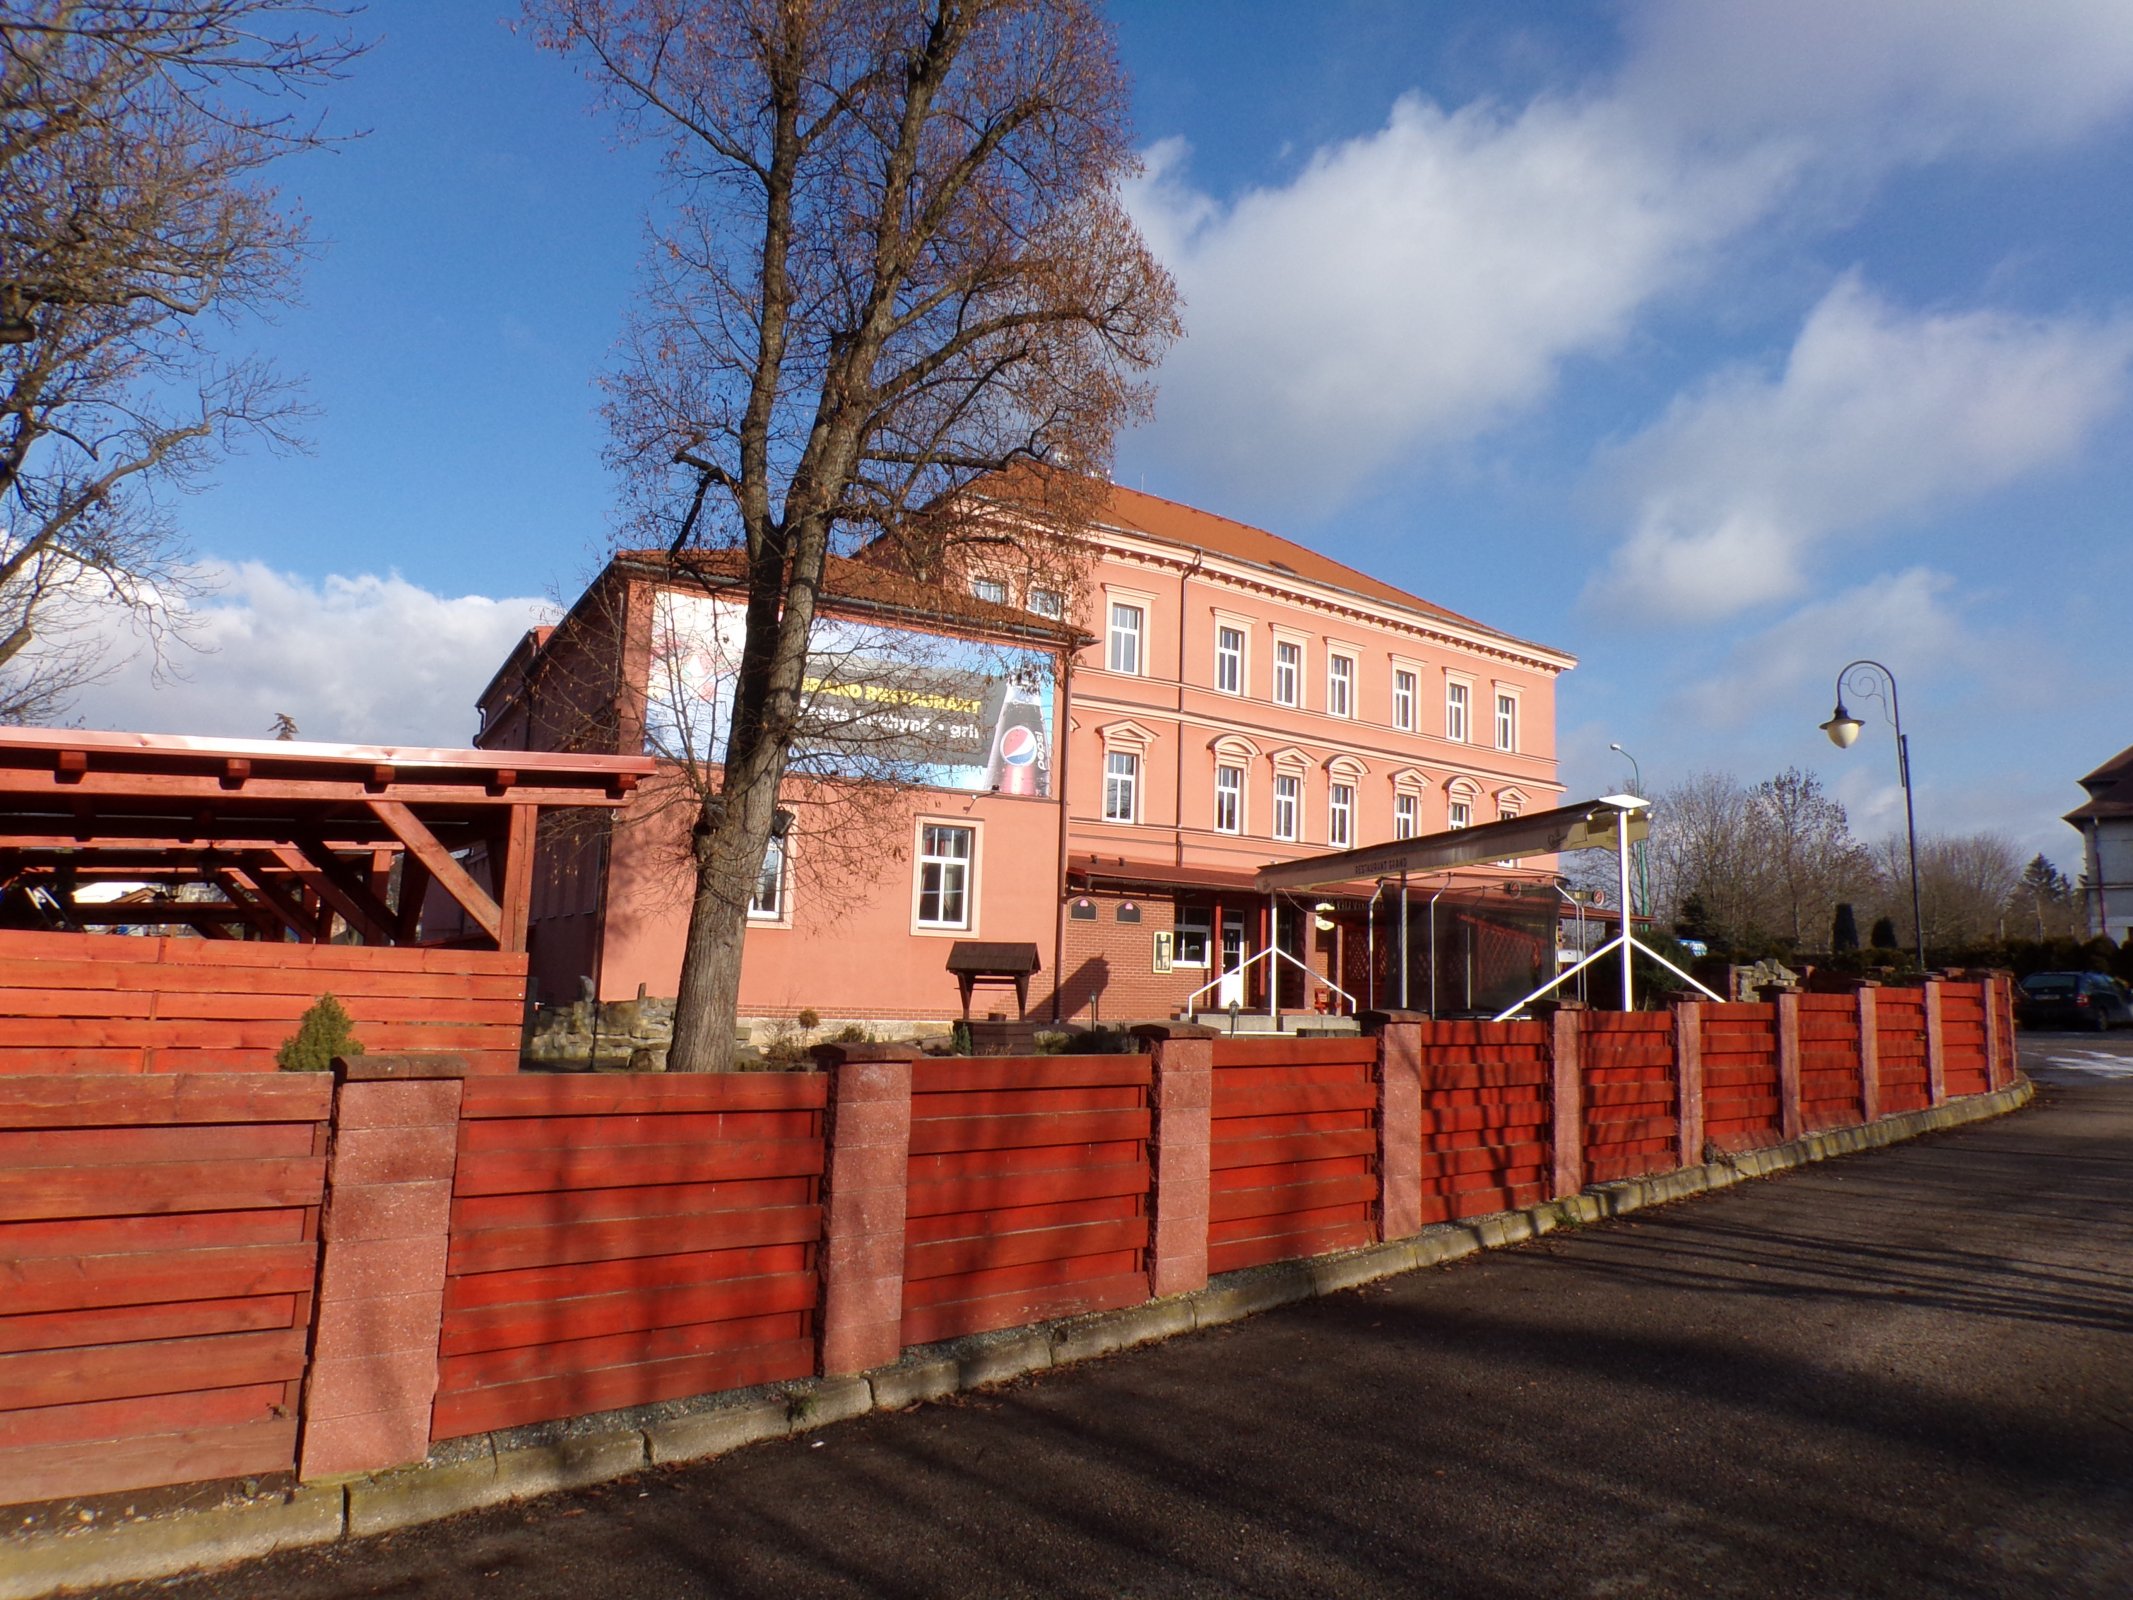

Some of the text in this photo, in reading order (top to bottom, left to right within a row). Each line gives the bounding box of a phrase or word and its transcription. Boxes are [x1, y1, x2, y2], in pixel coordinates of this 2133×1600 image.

[801, 677, 982, 714] GRAND RESTAURANT
[1034, 731, 1047, 771] pepsi
[1355, 860, 1388, 875] RESTAURANT
